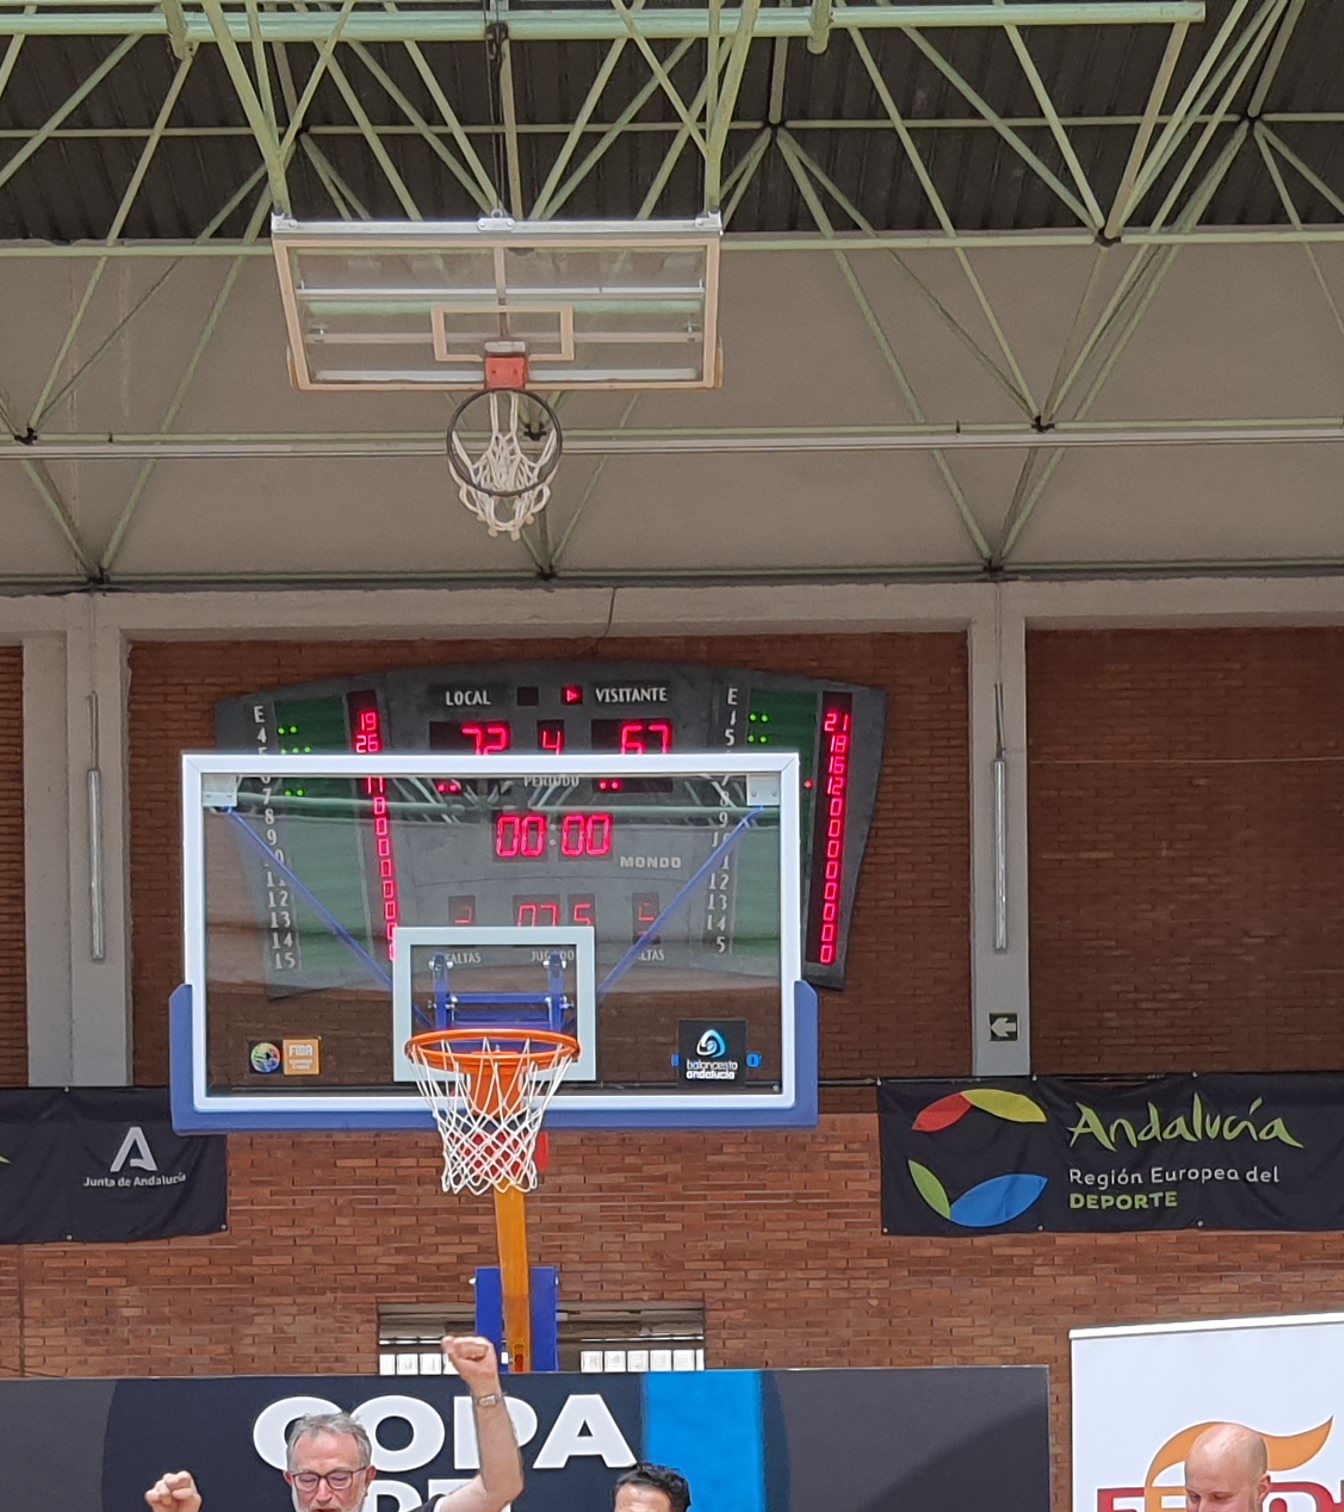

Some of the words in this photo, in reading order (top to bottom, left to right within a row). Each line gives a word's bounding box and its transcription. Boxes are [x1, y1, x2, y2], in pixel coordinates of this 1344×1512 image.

[446, 690, 491, 706] LOCAL
[595, 688, 668, 703] VISITANTE
[728, 688, 738, 705] E
[253, 706, 265, 723] E
[824, 714, 848, 731] 21
[257, 727, 267, 743] 4
[356, 734, 378, 753] 26
[265, 808, 274, 824] 8
[267, 829, 277, 845] 9
[620, 856, 681, 868] MONDO
[709, 873, 729, 890] 12
[268, 891, 288, 908] 12
[708, 894, 727, 910] 13
[271, 911, 291, 928] 13
[273, 932, 293, 949] 14
[274, 953, 296, 970] 15
[1066, 1092, 1303, 1152] Andalucía
[83, 1176, 113, 1188] Junta
[117, 1177, 131, 1187] de
[133, 1172, 186, 1187] Andalucía
[1070, 1167, 1143, 1190] Región
[1151, 1167, 1239, 1187] Europea
[1246, 1166, 1280, 1184] del
[1070, 1191, 1178, 1210] DEPORTE
